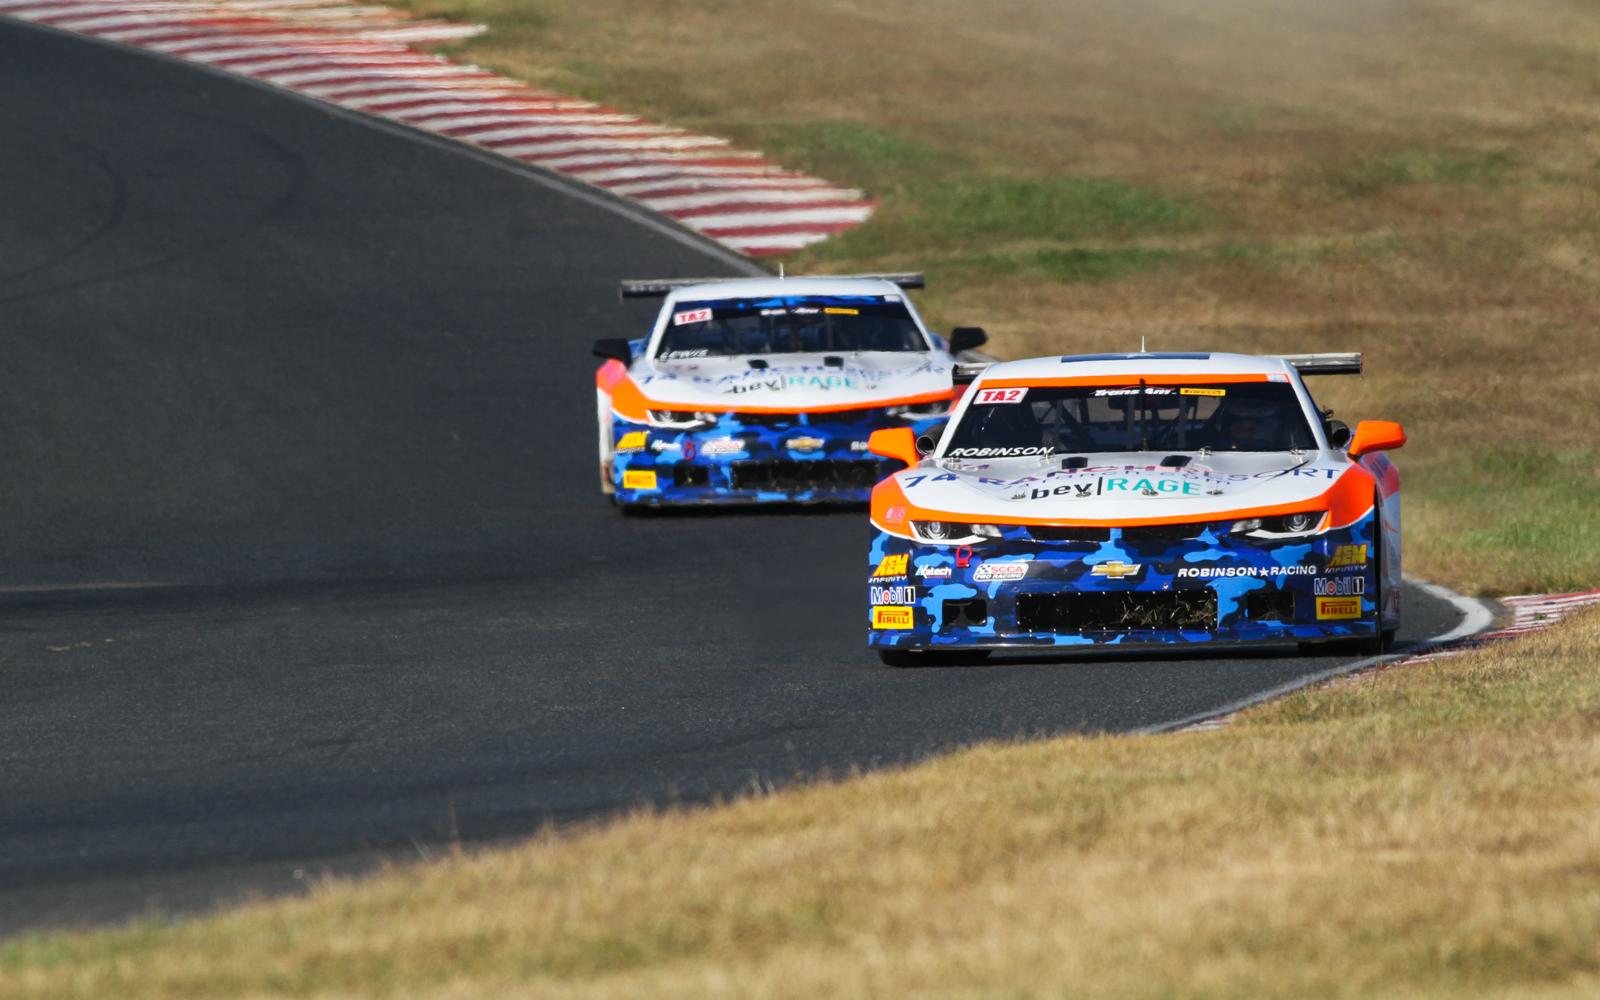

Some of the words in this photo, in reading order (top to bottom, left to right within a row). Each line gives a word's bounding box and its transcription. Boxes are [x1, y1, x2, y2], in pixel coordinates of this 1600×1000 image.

[679, 310, 708, 322] TA2
[982, 390, 1021, 401] TA2
[949, 446, 1055, 458] ROBINSON
[1328, 544, 1367, 567] AEM
[872, 553, 909, 577] AEM
[990, 565, 1024, 574] SCCA
[1177, 567, 1257, 578] ROBINSON
[1270, 565, 1317, 576] RACING
[1314, 576, 1352, 595] Mobil
[1352, 576, 1364, 595] 1
[871, 586, 904, 605] Mobil
[904, 586, 916, 604] 1
[1321, 601, 1358, 615] PIRELLI
[878, 610, 910, 624] PIRELLI
